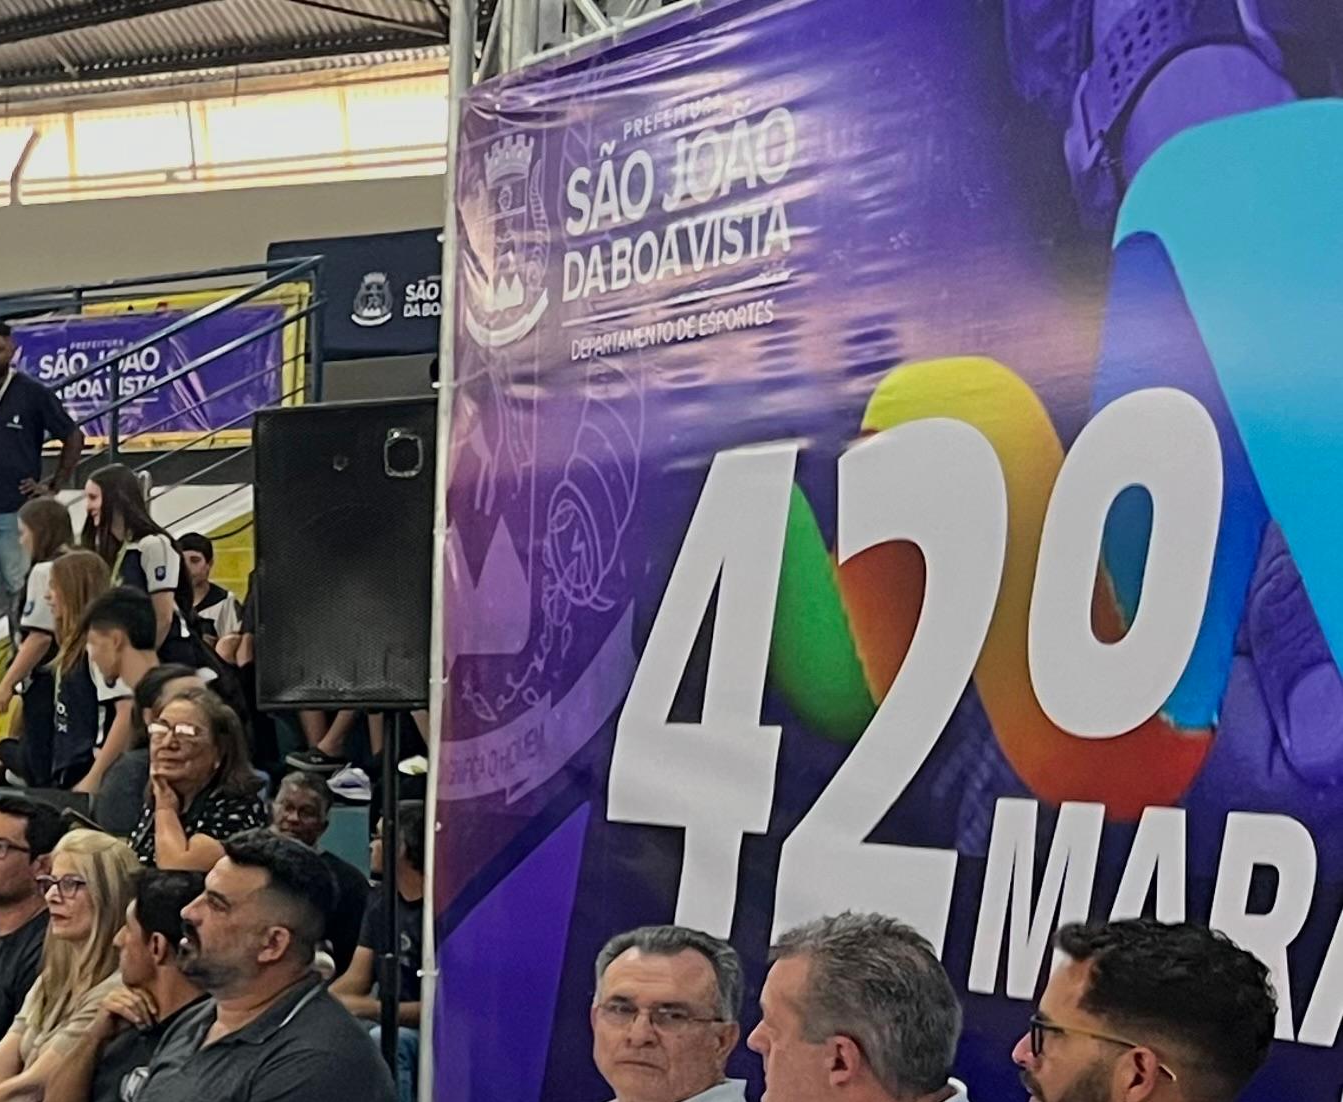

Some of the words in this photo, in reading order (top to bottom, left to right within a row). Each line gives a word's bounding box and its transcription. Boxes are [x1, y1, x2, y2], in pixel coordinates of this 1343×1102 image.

[566, 140, 654, 236] SÃO
[662, 99, 795, 212] JOÃO
[405, 279, 439, 301] SÃO
[563, 245, 607, 301] DA
[611, 221, 683, 290] BOA
[686, 200, 791, 272] VISTA
[39, 347, 88, 379] SÃO
[571, 321, 675, 360] DEPARTAMENTO
[677, 315, 696, 340] DE
[699, 299, 776, 337] ESPORTES
[968, 798, 1343, 1048] MAR
